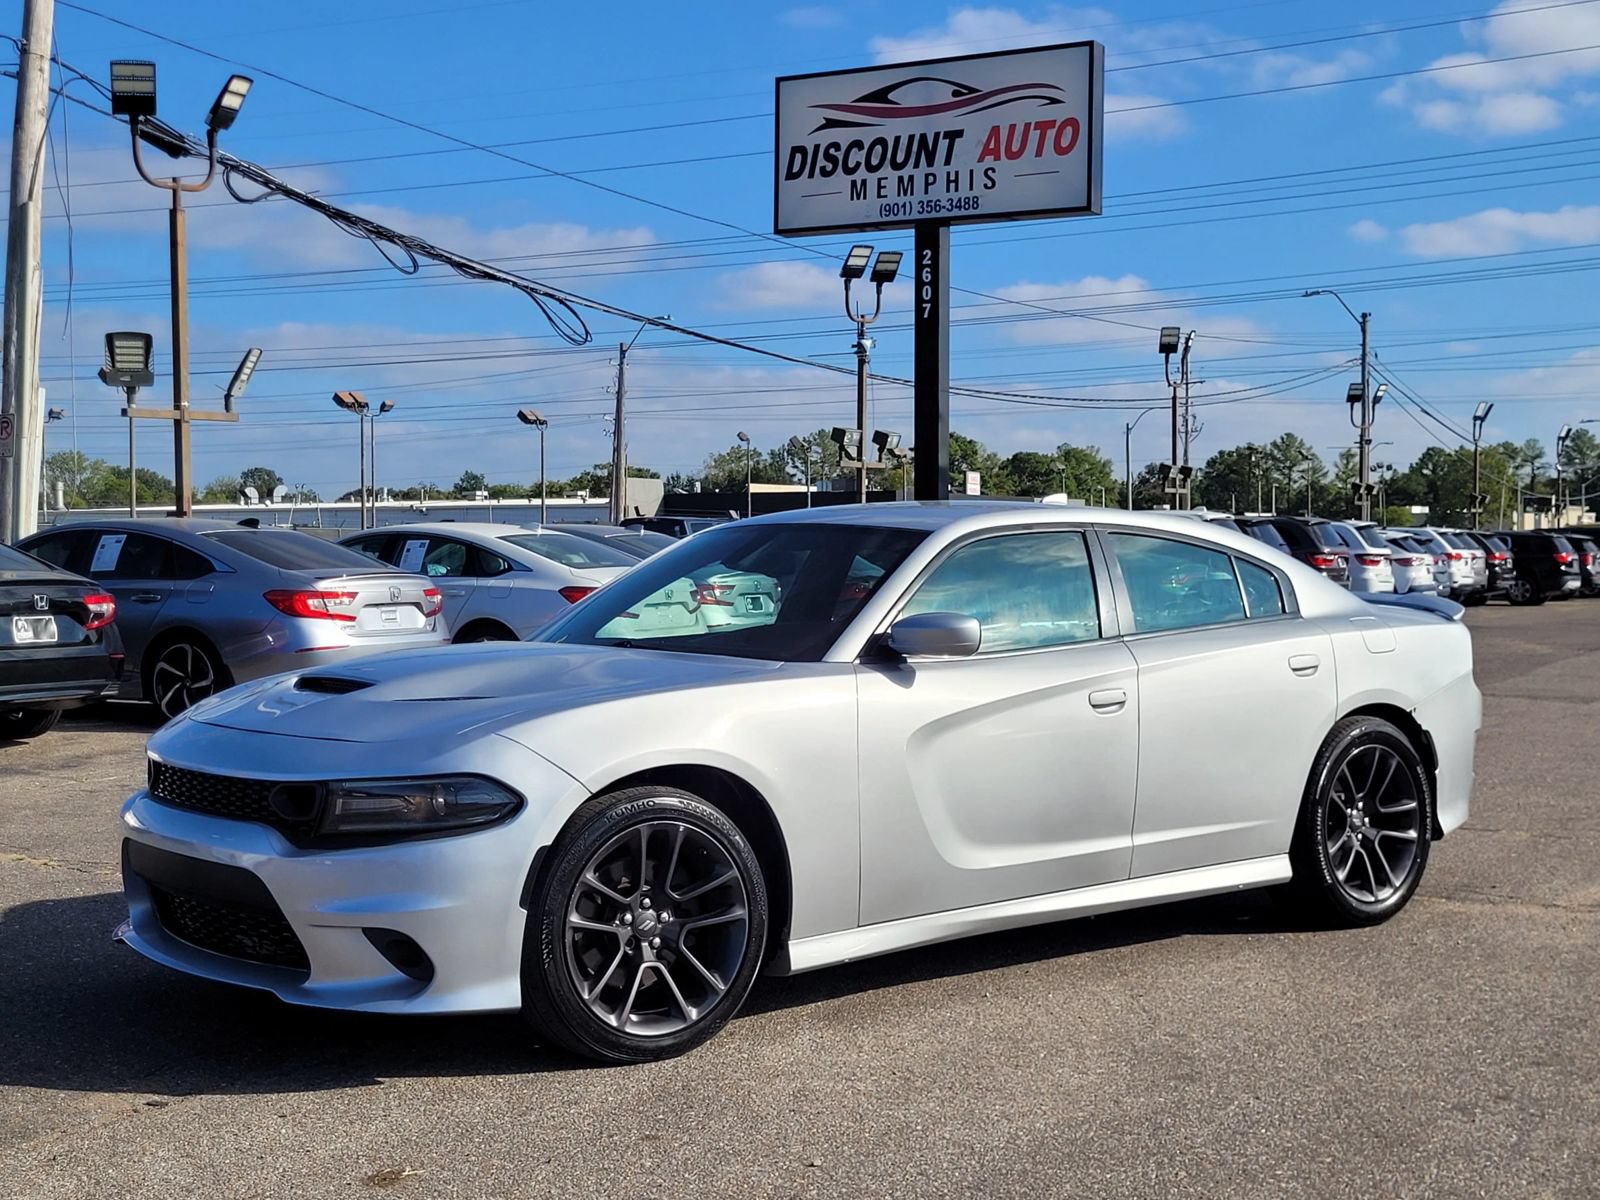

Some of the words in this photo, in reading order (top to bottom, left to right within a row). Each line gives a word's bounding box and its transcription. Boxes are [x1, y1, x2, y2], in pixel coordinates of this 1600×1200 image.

[784, 129, 964, 182] DISCOUNT
[976, 117, 1080, 163] AUTO
[850, 167, 997, 201] MEMPHIS
[879, 201, 913, 219] (901)
[917, 196, 980, 215] 356-3488
[921, 249, 932, 319] 2607
[605, 799, 656, 823] KUMHO
